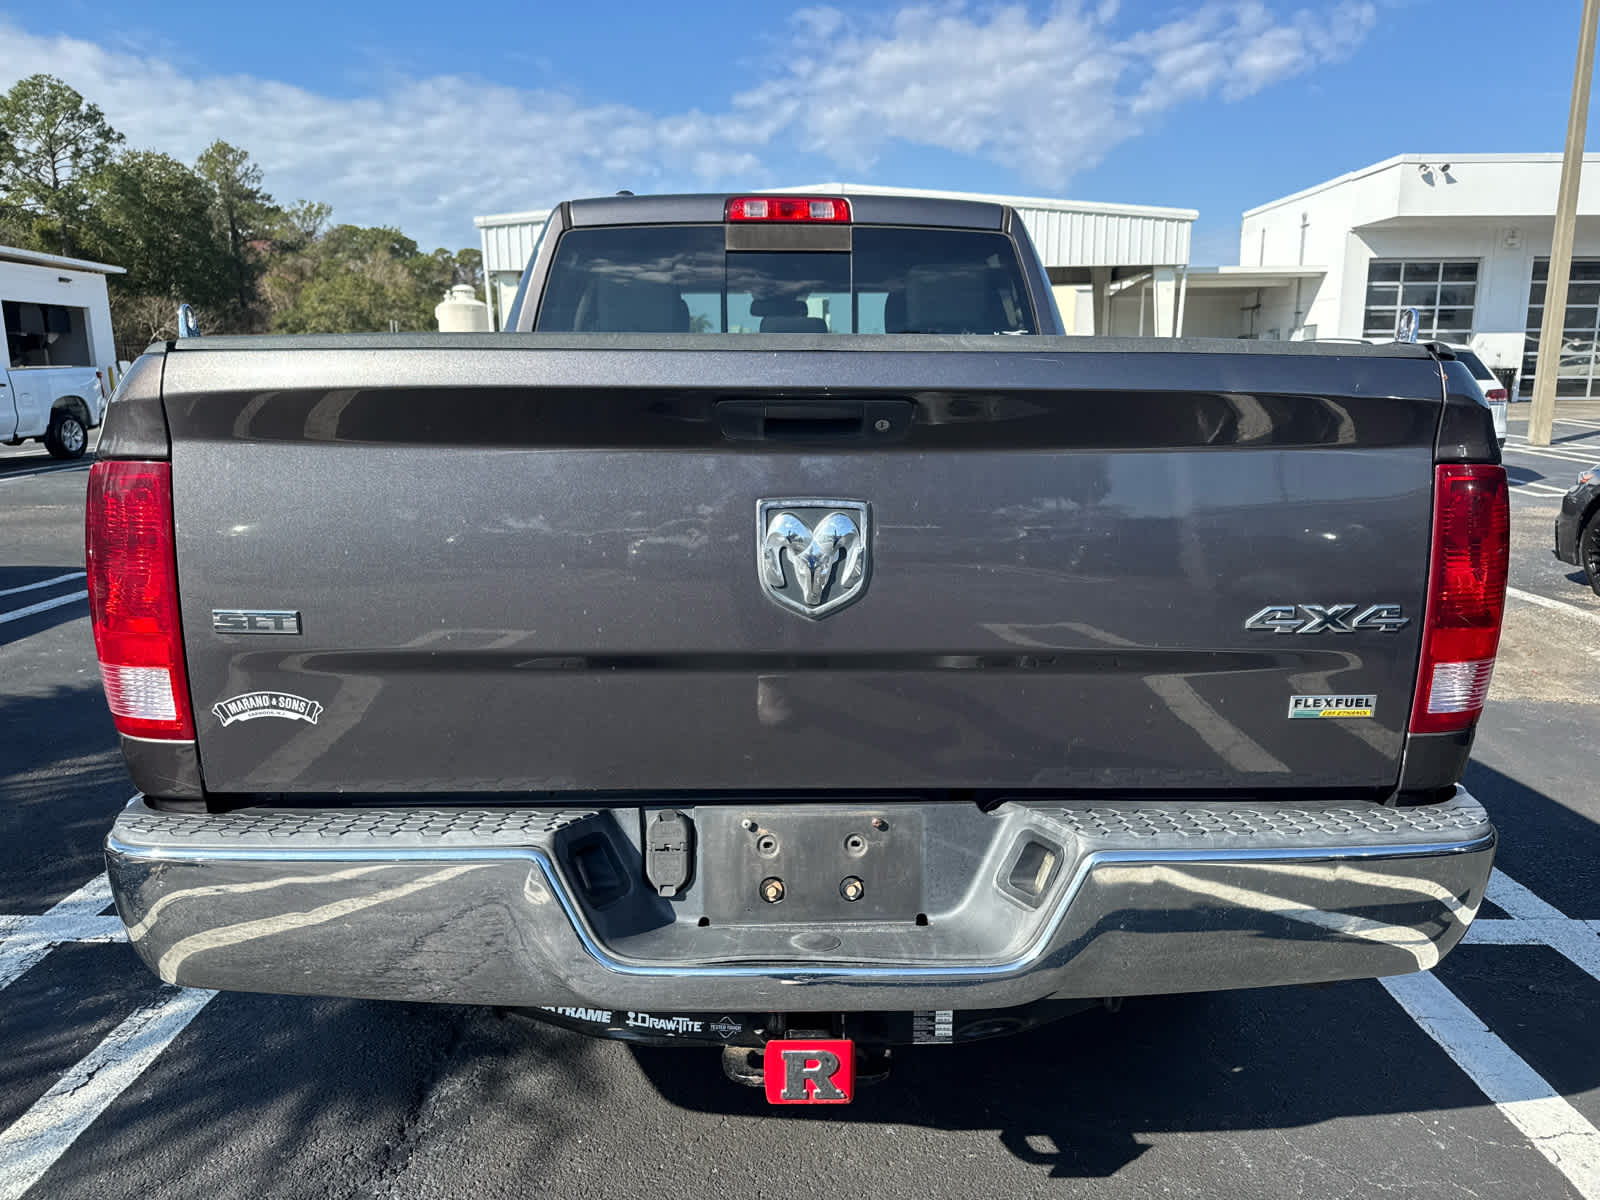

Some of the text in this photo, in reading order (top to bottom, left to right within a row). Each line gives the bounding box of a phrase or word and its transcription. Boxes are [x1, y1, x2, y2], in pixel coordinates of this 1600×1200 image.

[213, 611, 299, 632] SLT
[227, 696, 270, 714] MARANO
[279, 697, 307, 712] SONS
[781, 1050, 847, 1100] R
